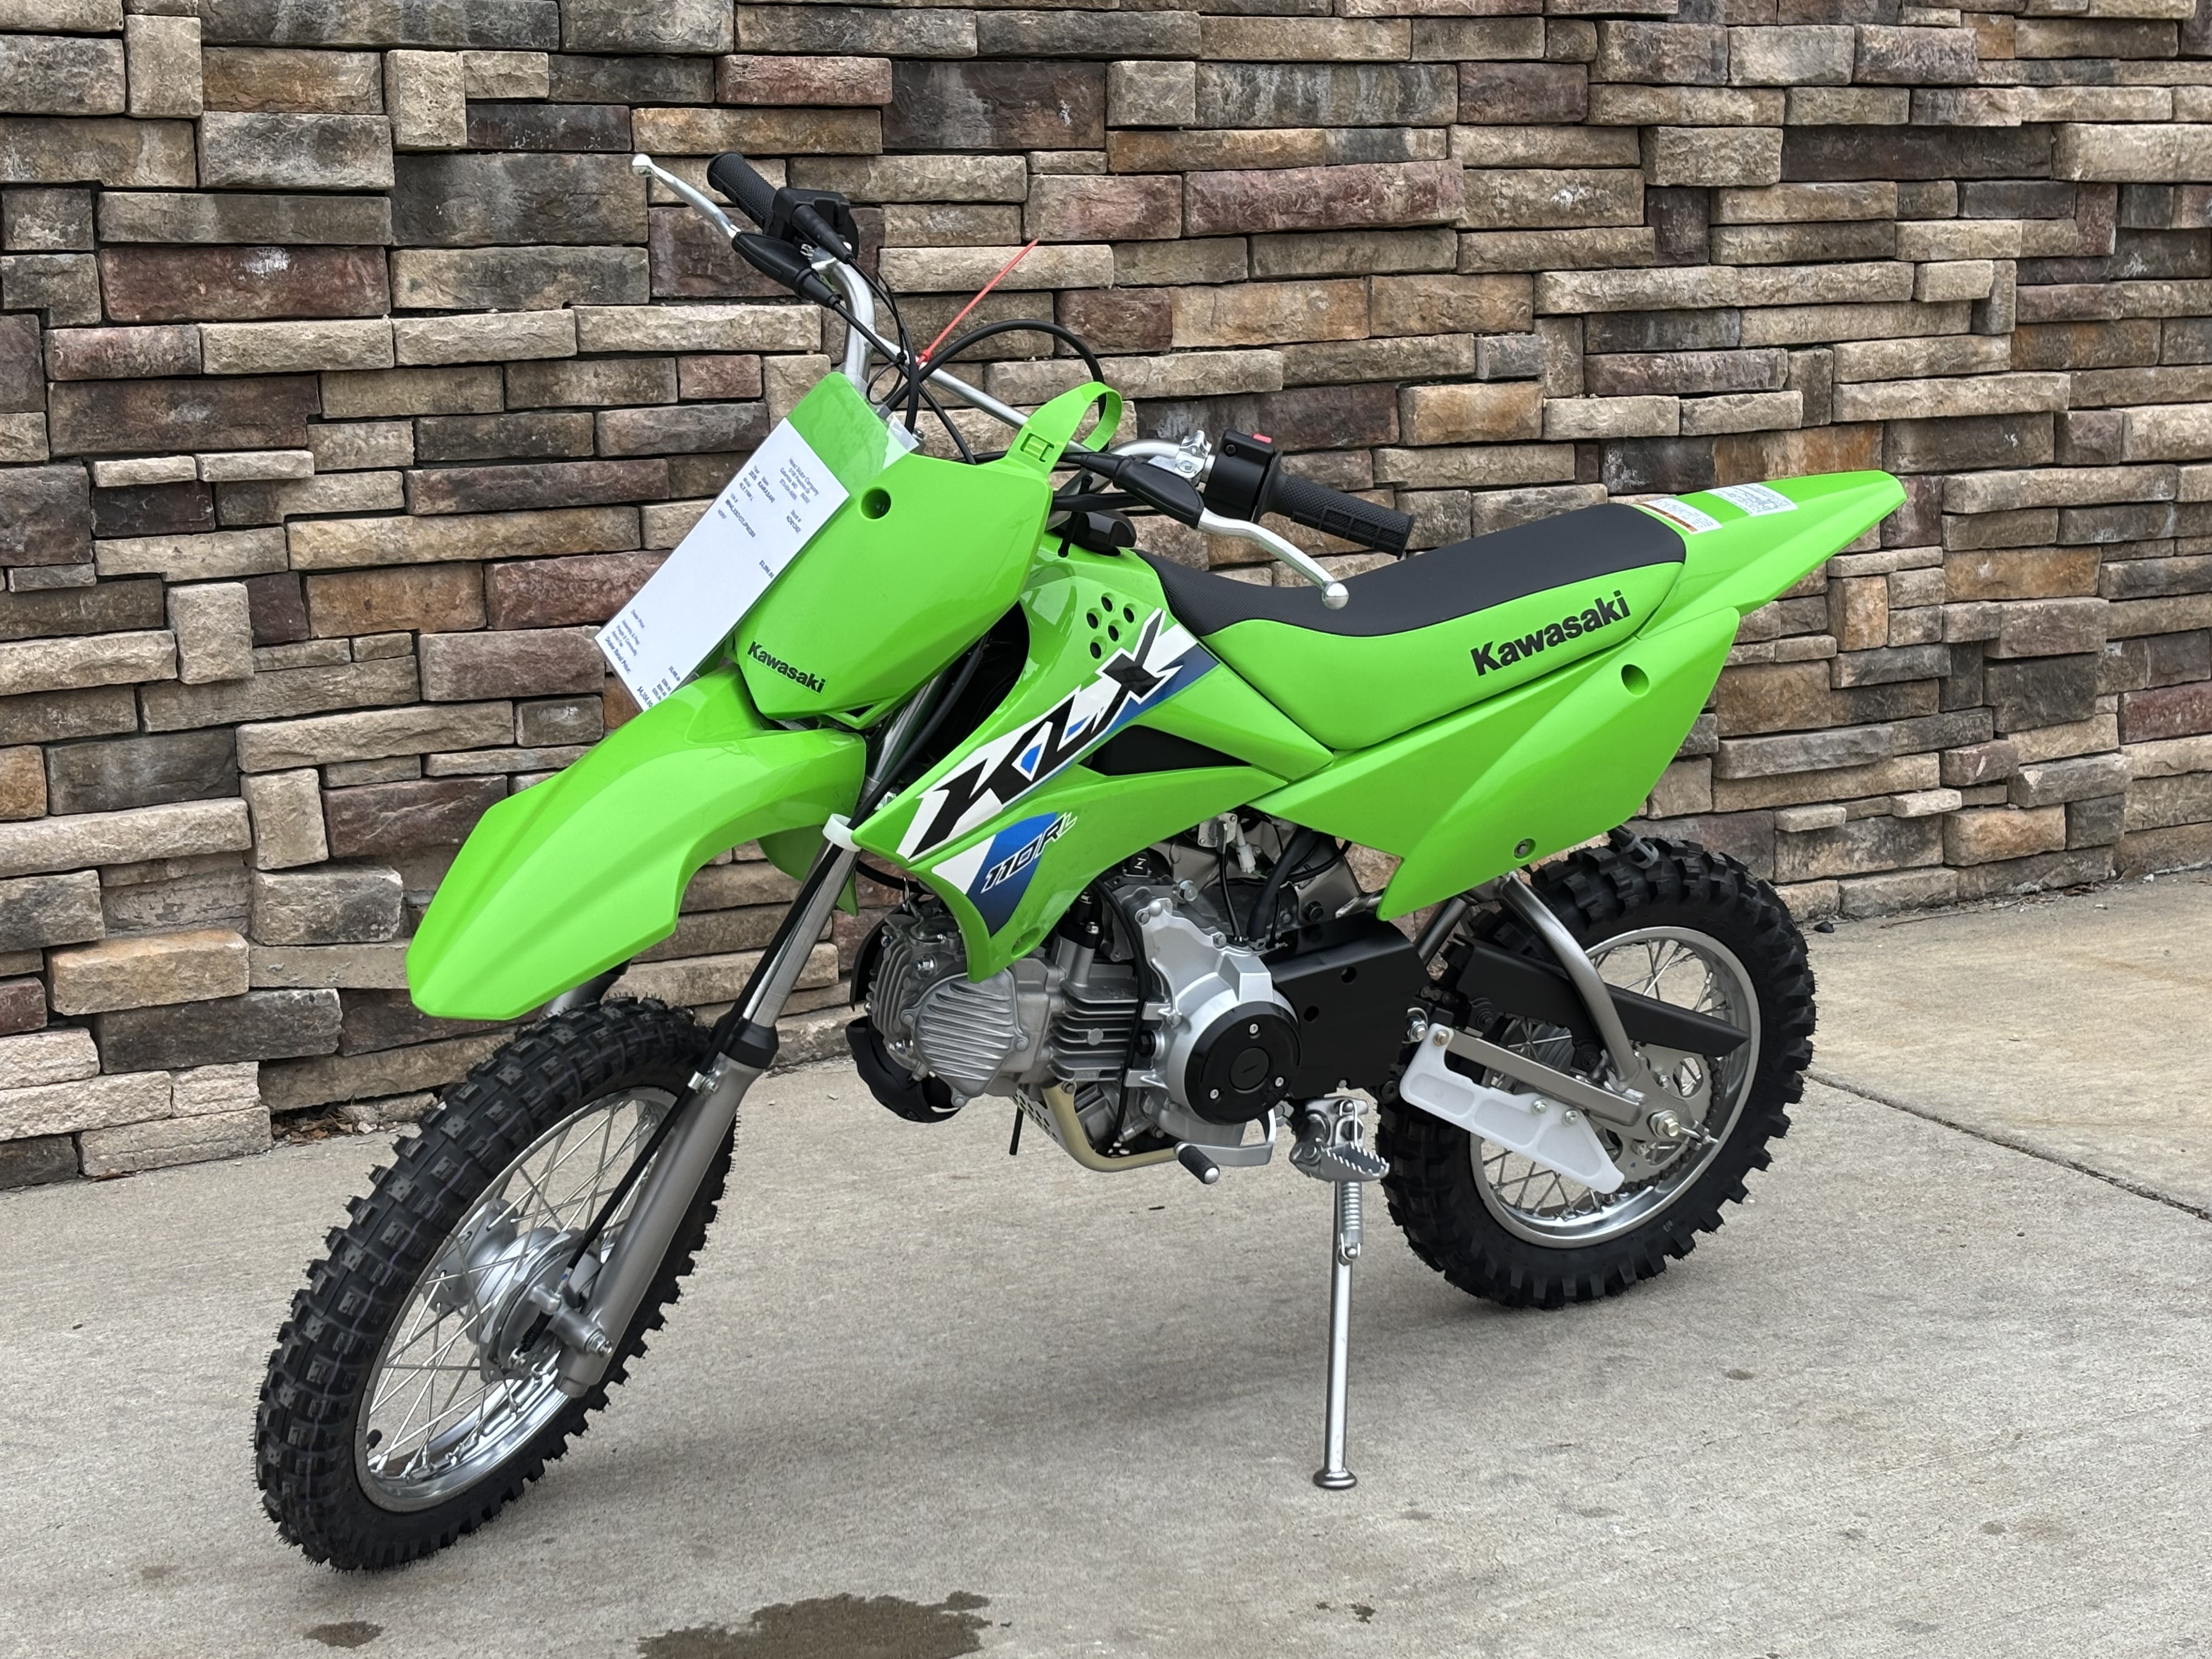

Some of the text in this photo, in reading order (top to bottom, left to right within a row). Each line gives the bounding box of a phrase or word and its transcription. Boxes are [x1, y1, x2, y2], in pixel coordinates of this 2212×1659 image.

[747, 641, 826, 693] Kawasaki
[1470, 590, 1630, 676] Kawasaki
[906, 608, 1184, 860] KLX
